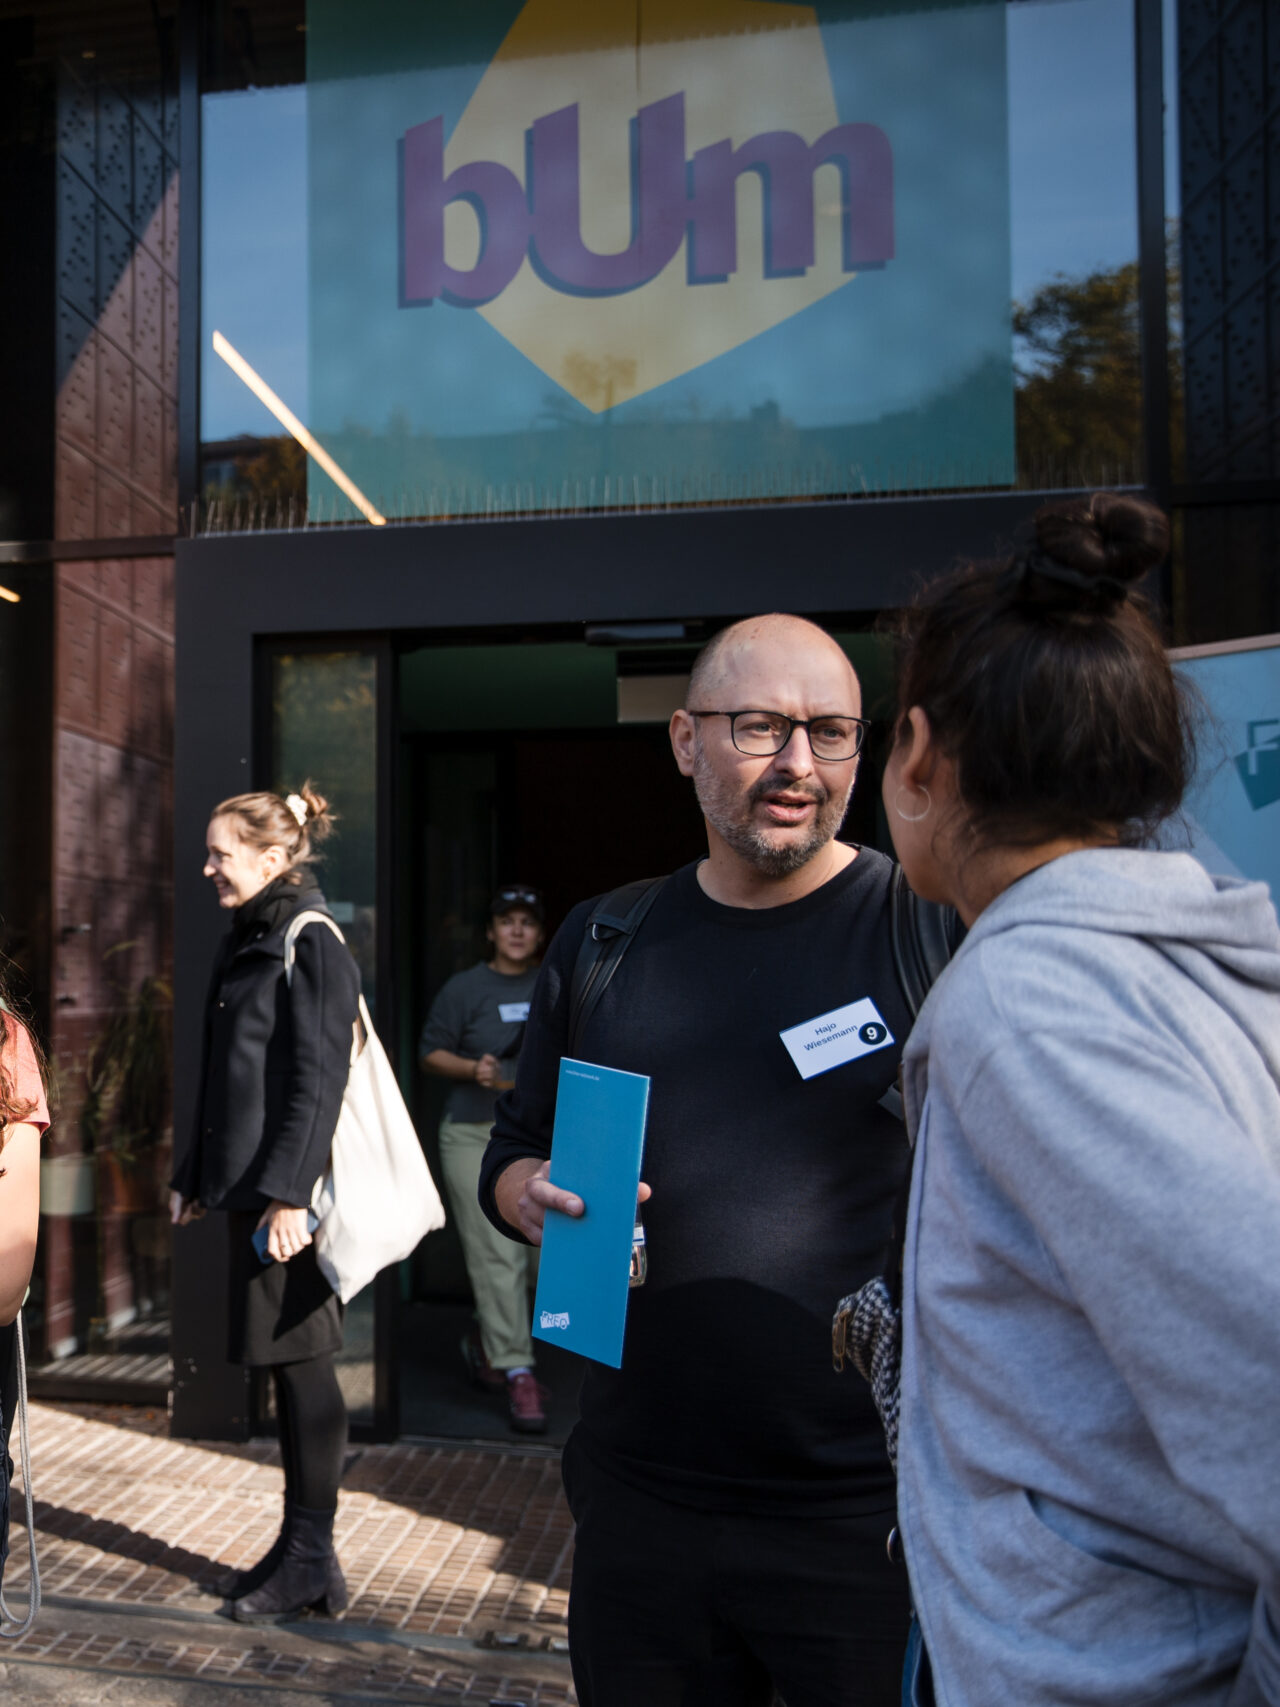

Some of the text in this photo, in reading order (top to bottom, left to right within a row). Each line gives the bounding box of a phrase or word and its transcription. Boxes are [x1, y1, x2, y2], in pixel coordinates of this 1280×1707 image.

[397, 90, 896, 310] bUm
[804, 1024, 858, 1051] Wiesemann
[815, 1022, 837, 1036] Hajo
[866, 1026, 878, 1040] 9
